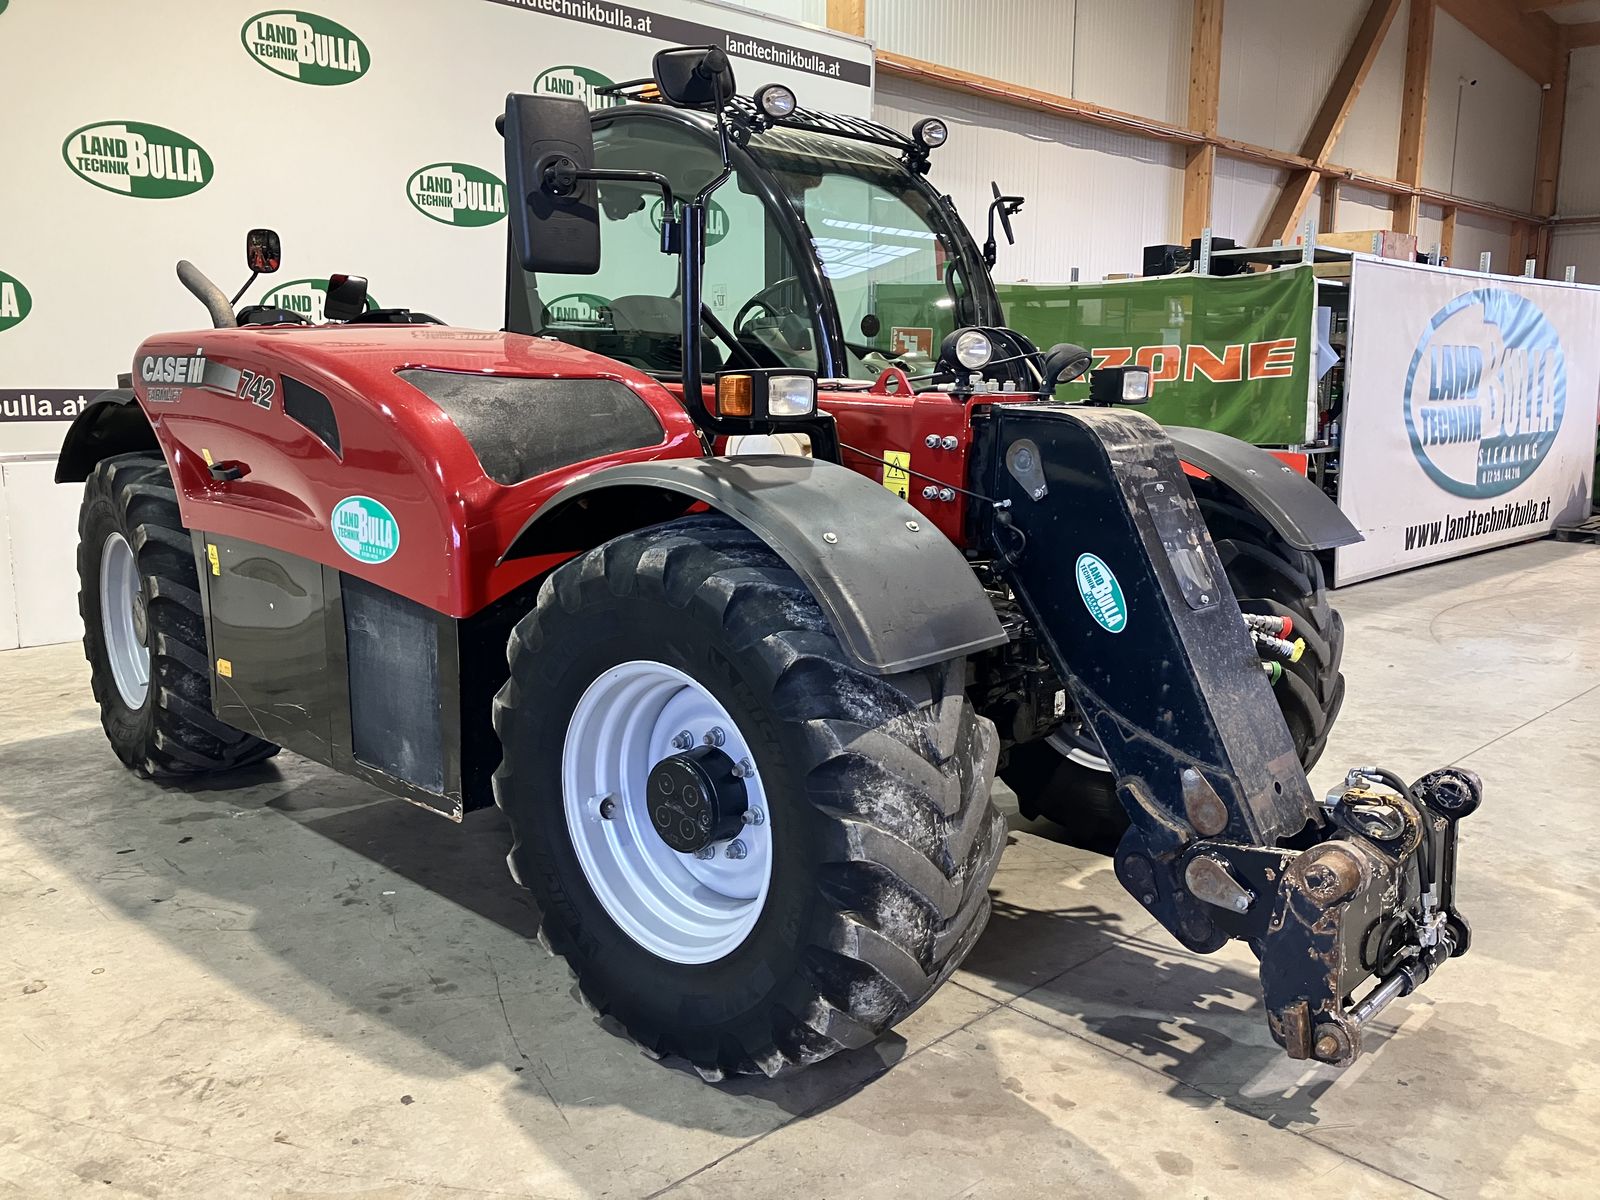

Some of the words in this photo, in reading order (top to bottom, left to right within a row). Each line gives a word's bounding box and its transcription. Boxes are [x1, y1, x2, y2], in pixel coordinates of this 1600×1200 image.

[257, 21, 297, 46] LAND
[297, 21, 361, 73] BULLA
[253, 41, 299, 62] TECHNIK
[725, 34, 841, 77] landtechnikbulla.at
[545, 75, 574, 96] LAND
[81, 134, 128, 159] LAND
[127, 132, 203, 183] BULLA
[76, 156, 130, 176] TECHNIK
[420, 174, 452, 194] LAND
[452, 172, 505, 213] BULLA
[416, 193, 453, 208] TECHNIK
[274, 294, 312, 313] LAND
[142, 356, 188, 383] CASE
[1072, 338, 1297, 383] ZONE
[1429, 344, 1483, 401] LAND
[239, 368, 276, 410] 742
[1482, 322, 1555, 438] BULLA
[0, 394, 88, 417] ulla.at
[340, 510, 359, 529] LAND
[359, 507, 393, 550] BULLA
[1405, 497, 1551, 551] www.landtechnikbulla.at
[1080, 563, 1097, 590] TECHNIK
[1087, 561, 1105, 586] LAND
[1092, 579, 1124, 628] BULLA
